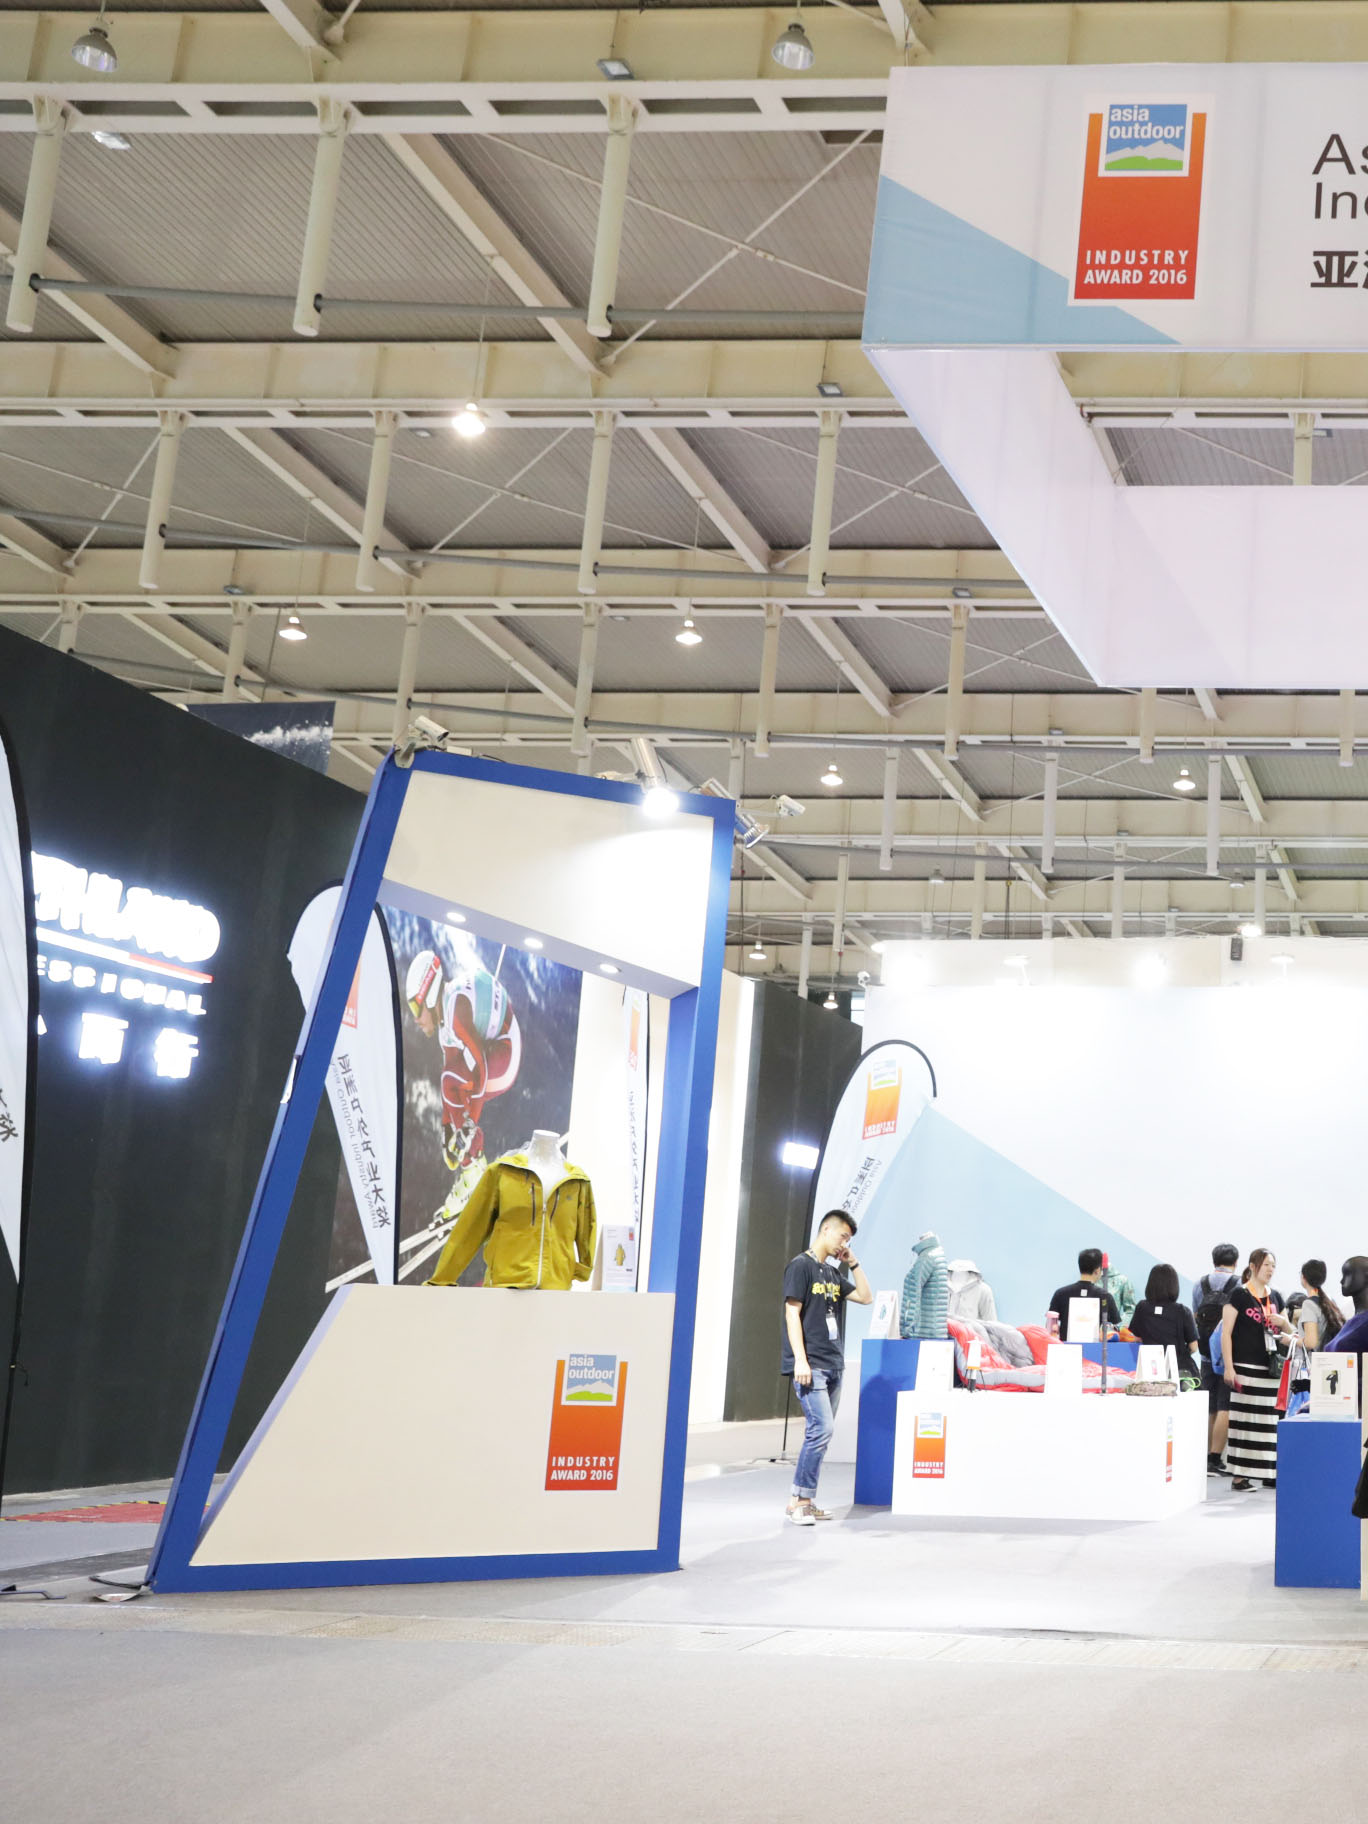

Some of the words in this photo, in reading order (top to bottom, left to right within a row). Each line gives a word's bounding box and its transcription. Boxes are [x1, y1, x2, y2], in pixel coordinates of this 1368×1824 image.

[1110, 105, 1149, 122] asia
[1109, 123, 1184, 139] outdoor
[1086, 250, 1189, 265] INDUSTRY
[1084, 269, 1143, 284] AWARD
[1149, 269, 1187, 285] 2016
[570, 1355, 594, 1367] asia
[569, 1368, 614, 1380] outdoor
[552, 1456, 615, 1467] INDUSTRY
[550, 1470, 587, 1480] AWARD
[590, 1470, 613, 1480] 2016
